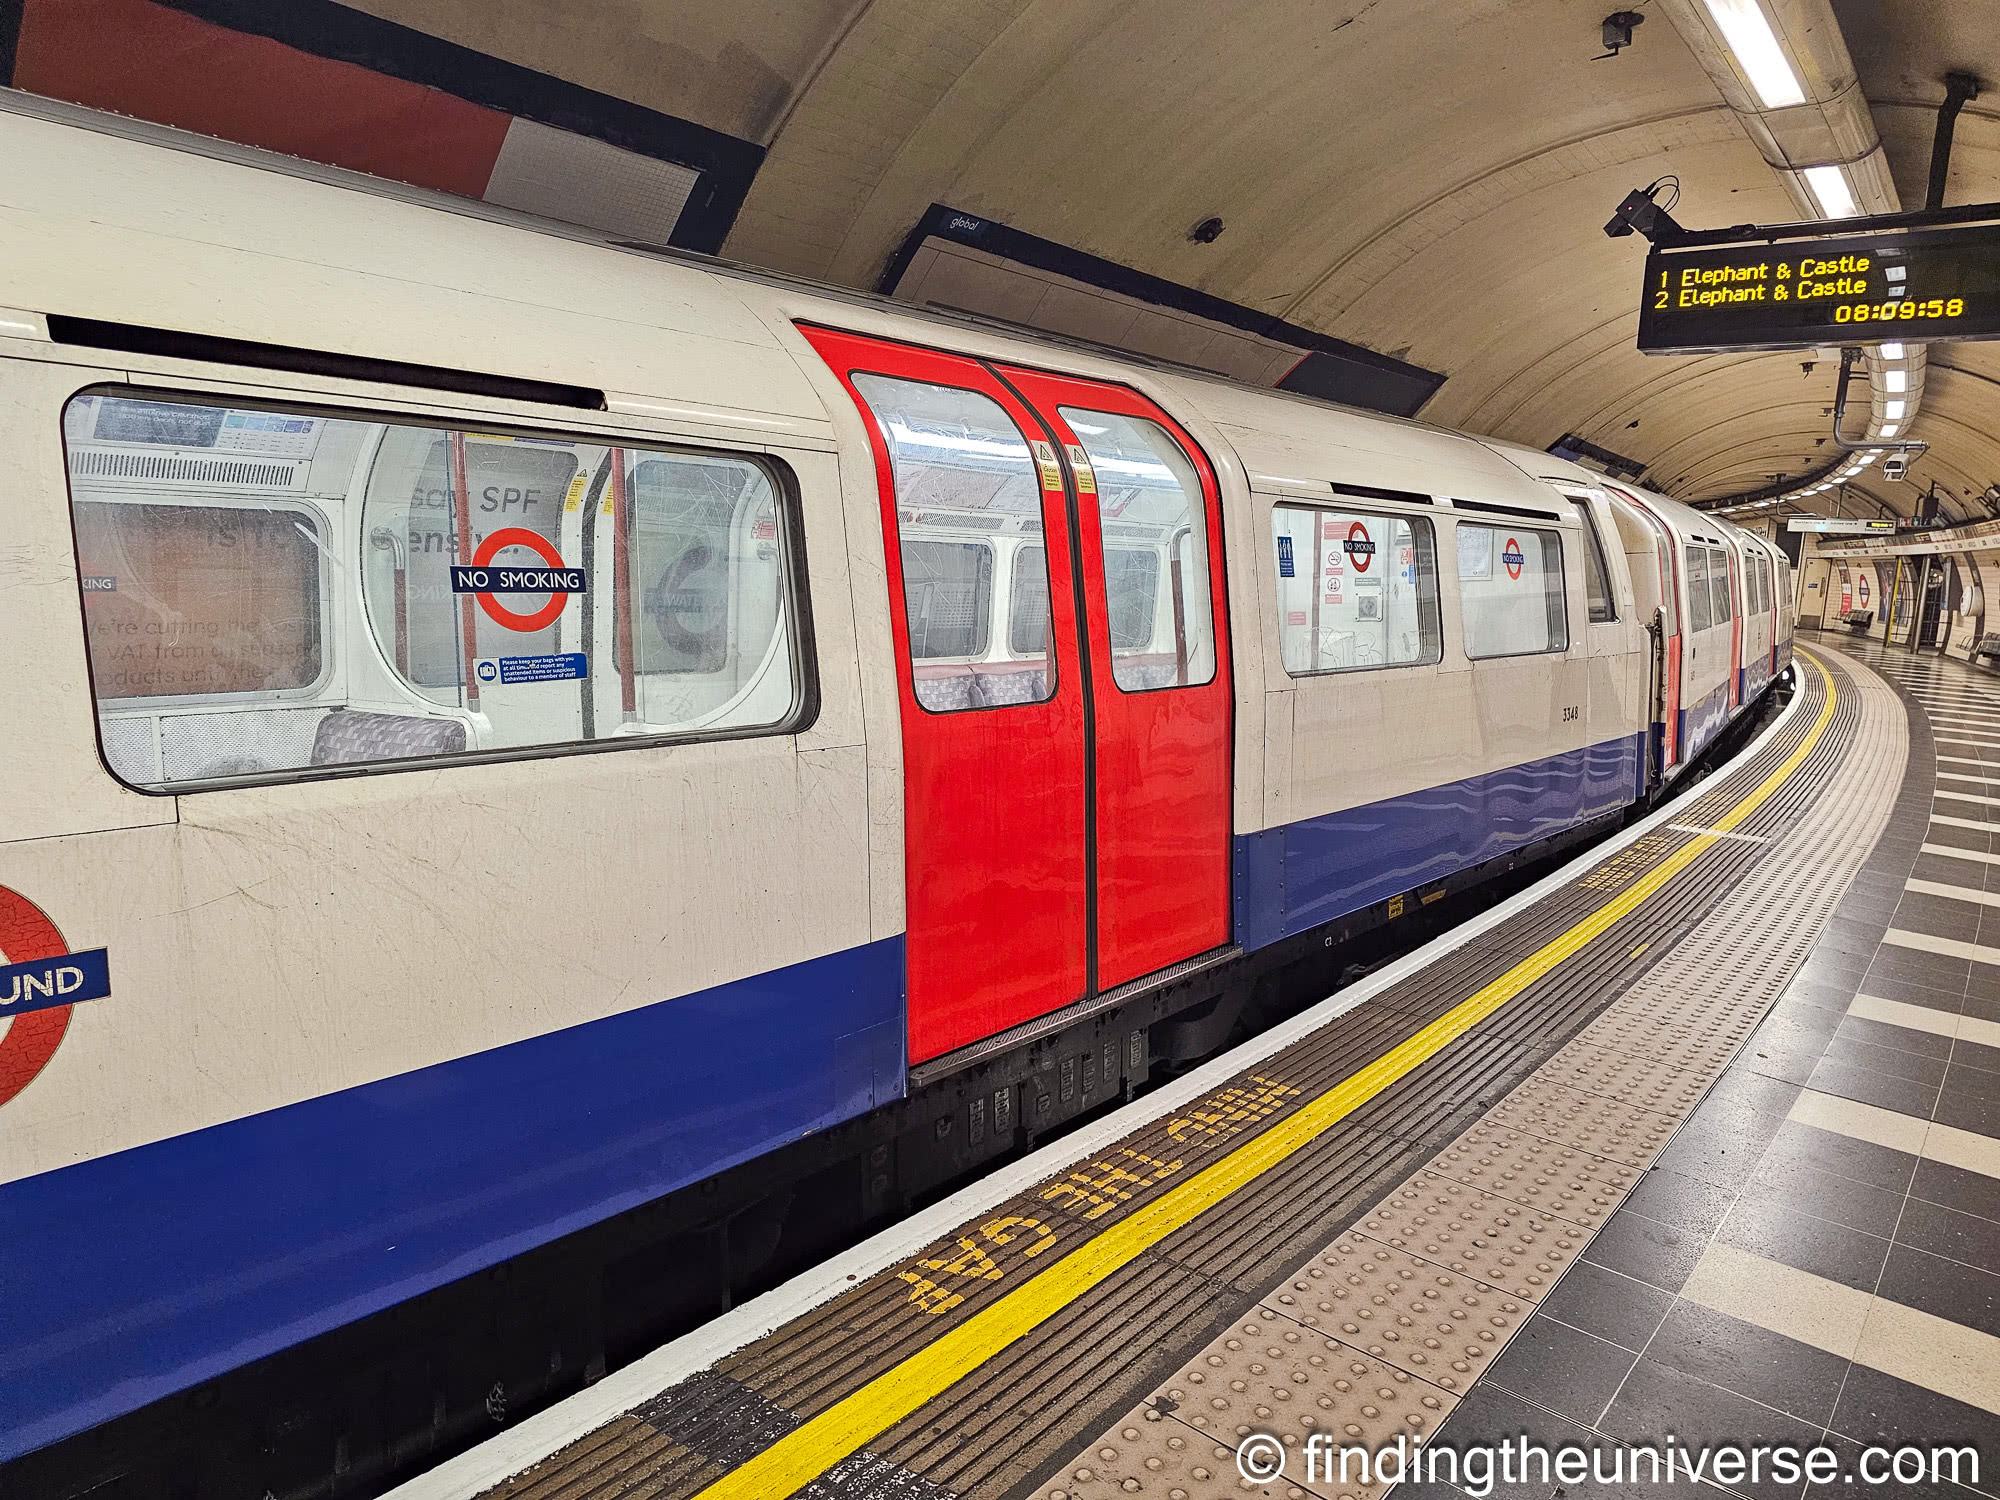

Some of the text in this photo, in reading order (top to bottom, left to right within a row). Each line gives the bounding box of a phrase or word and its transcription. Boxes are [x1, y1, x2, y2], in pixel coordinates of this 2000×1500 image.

[950, 217, 980, 231] global
[1661, 256, 1870, 288] 1 Elephant & Castle
[1654, 277, 1867, 309] 2 Elephant & Castle
[1835, 298, 1964, 323] 08:09:58
[479, 486, 541, 513] SPF
[1344, 542, 1375, 552] NO SMOKING
[458, 571, 580, 588] NO SMOKING
[145, 619, 218, 638] cutting
[107, 644, 147, 660] VAT
[1562, 705, 1579, 722] 3348
[0, 966, 84, 1006] UND
[1040, 1148, 1183, 1220] THE
[896, 1215, 1058, 1315] GAP
